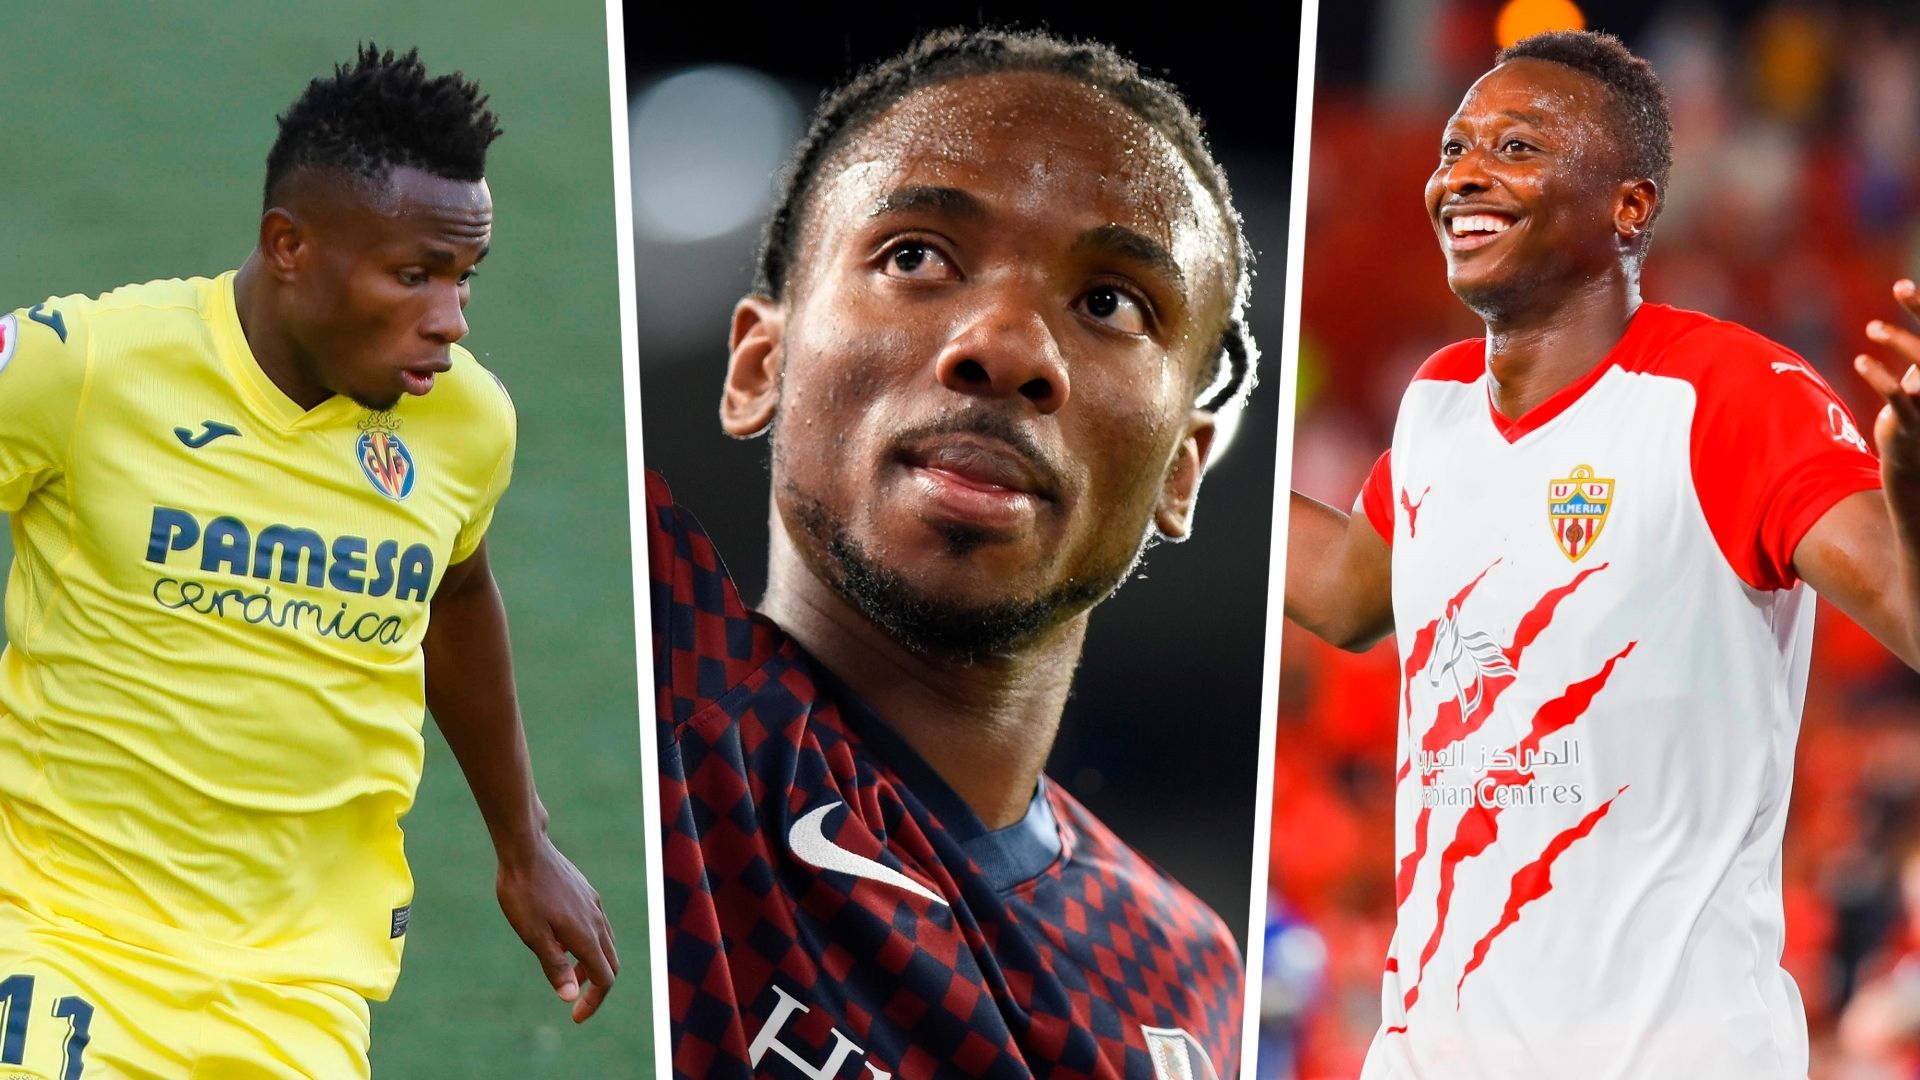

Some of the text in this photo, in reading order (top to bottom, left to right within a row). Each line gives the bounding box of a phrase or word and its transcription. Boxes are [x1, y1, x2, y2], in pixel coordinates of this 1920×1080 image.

[1554, 484, 1604, 497] U D
[1552, 503, 1603, 514] ALMERIA
[145, 505, 435, 603] PAMESA
[153, 576, 402, 645] cerámica
[1473, 739, 1580, 773] المراكز
[1478, 779, 1583, 805] Centres
[0, 974, 95, 1080] 11
